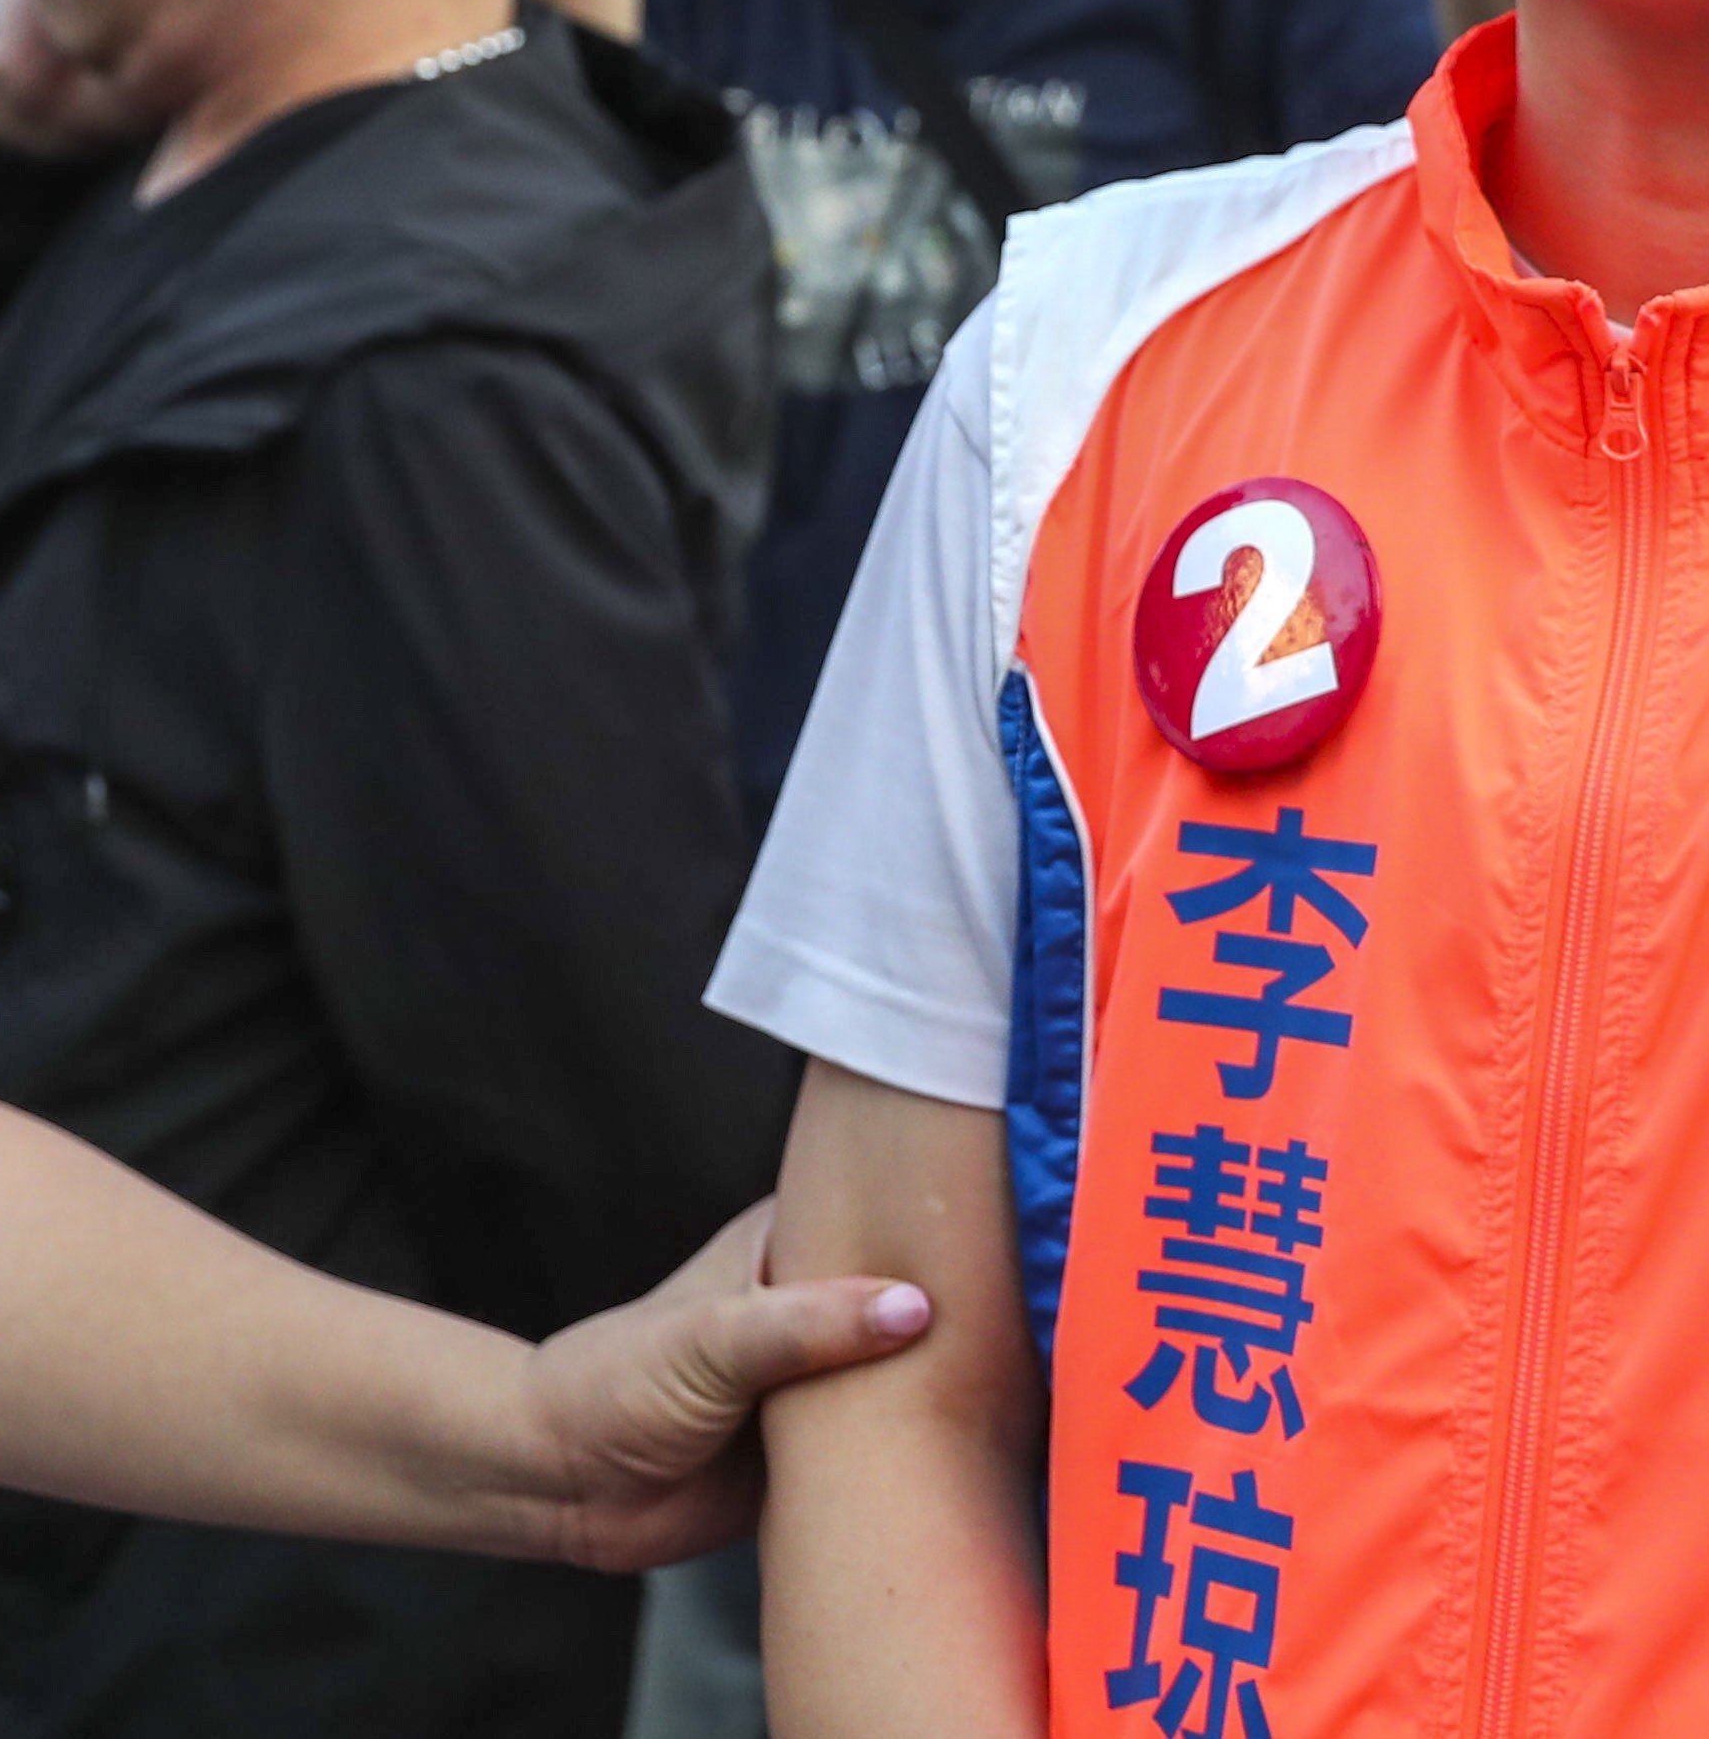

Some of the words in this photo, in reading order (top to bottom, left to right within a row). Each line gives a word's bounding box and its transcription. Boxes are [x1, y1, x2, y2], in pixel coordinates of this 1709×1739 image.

[1172, 498, 1339, 741] 2
[1105, 805, 1378, 1739] 李慧琼
